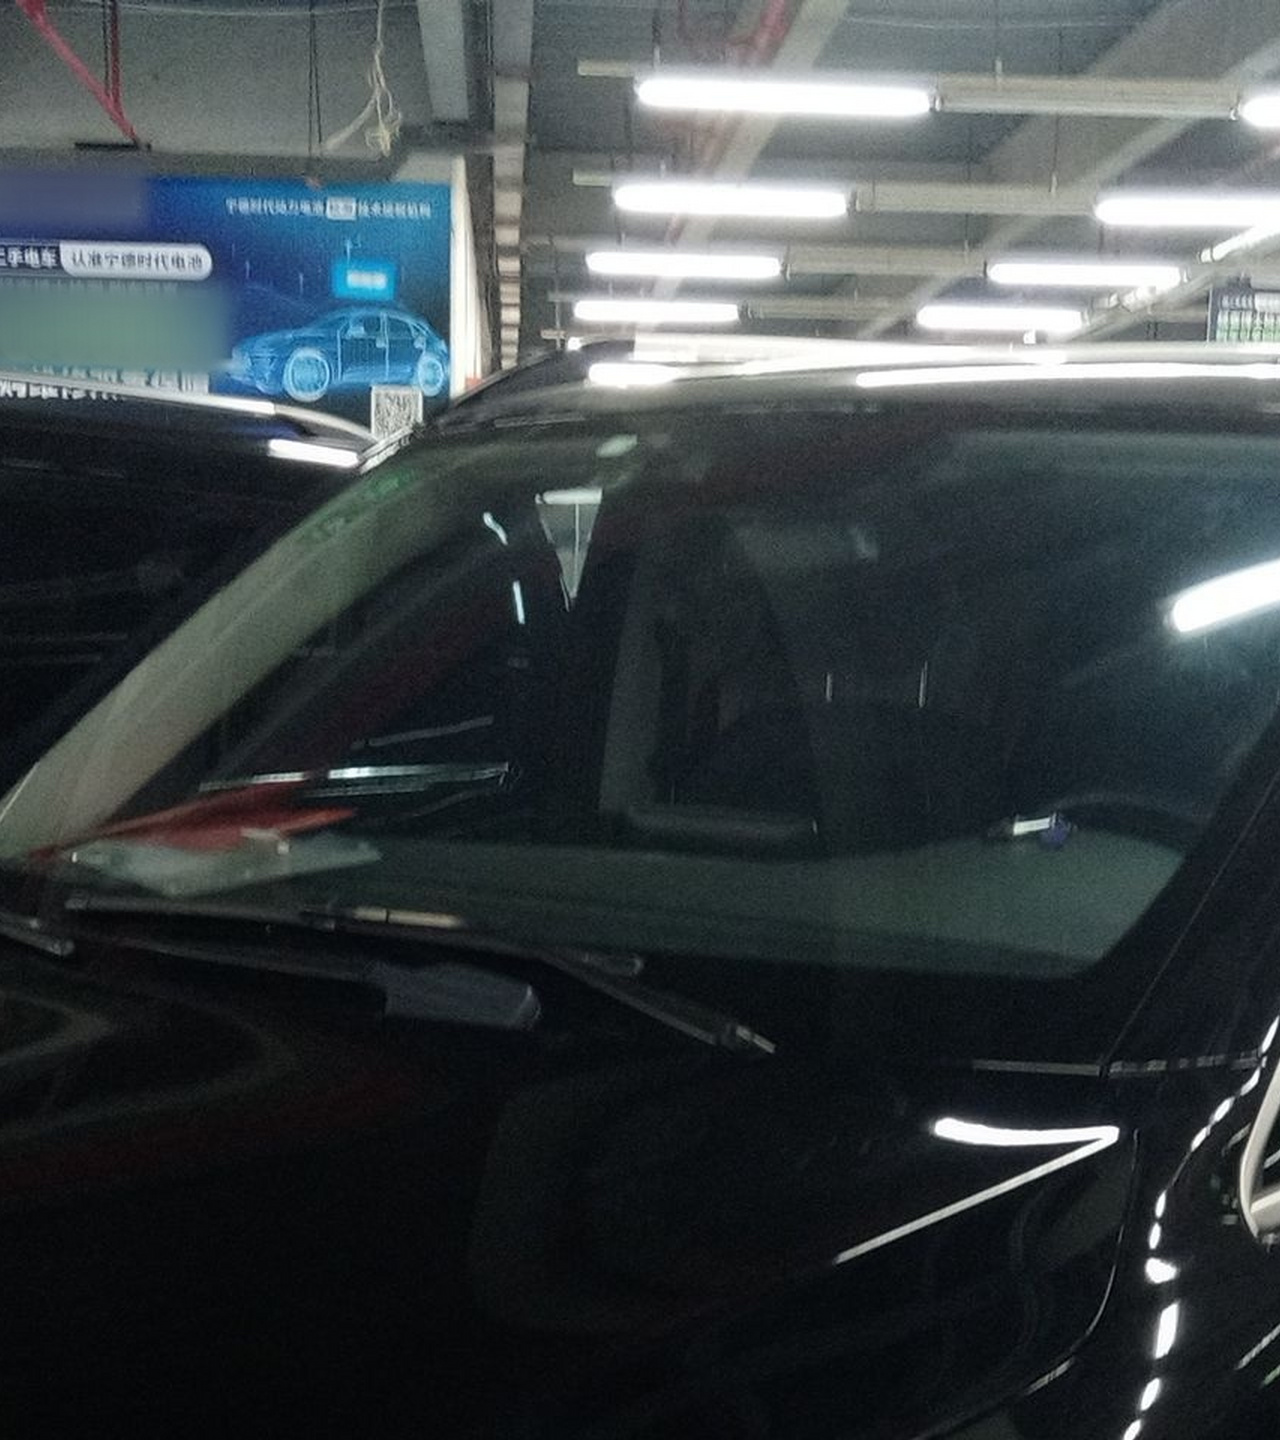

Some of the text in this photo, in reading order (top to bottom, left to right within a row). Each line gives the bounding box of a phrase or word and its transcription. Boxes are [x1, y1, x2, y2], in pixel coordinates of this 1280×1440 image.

[71, 248, 204, 271] 认准宁德时代电池
